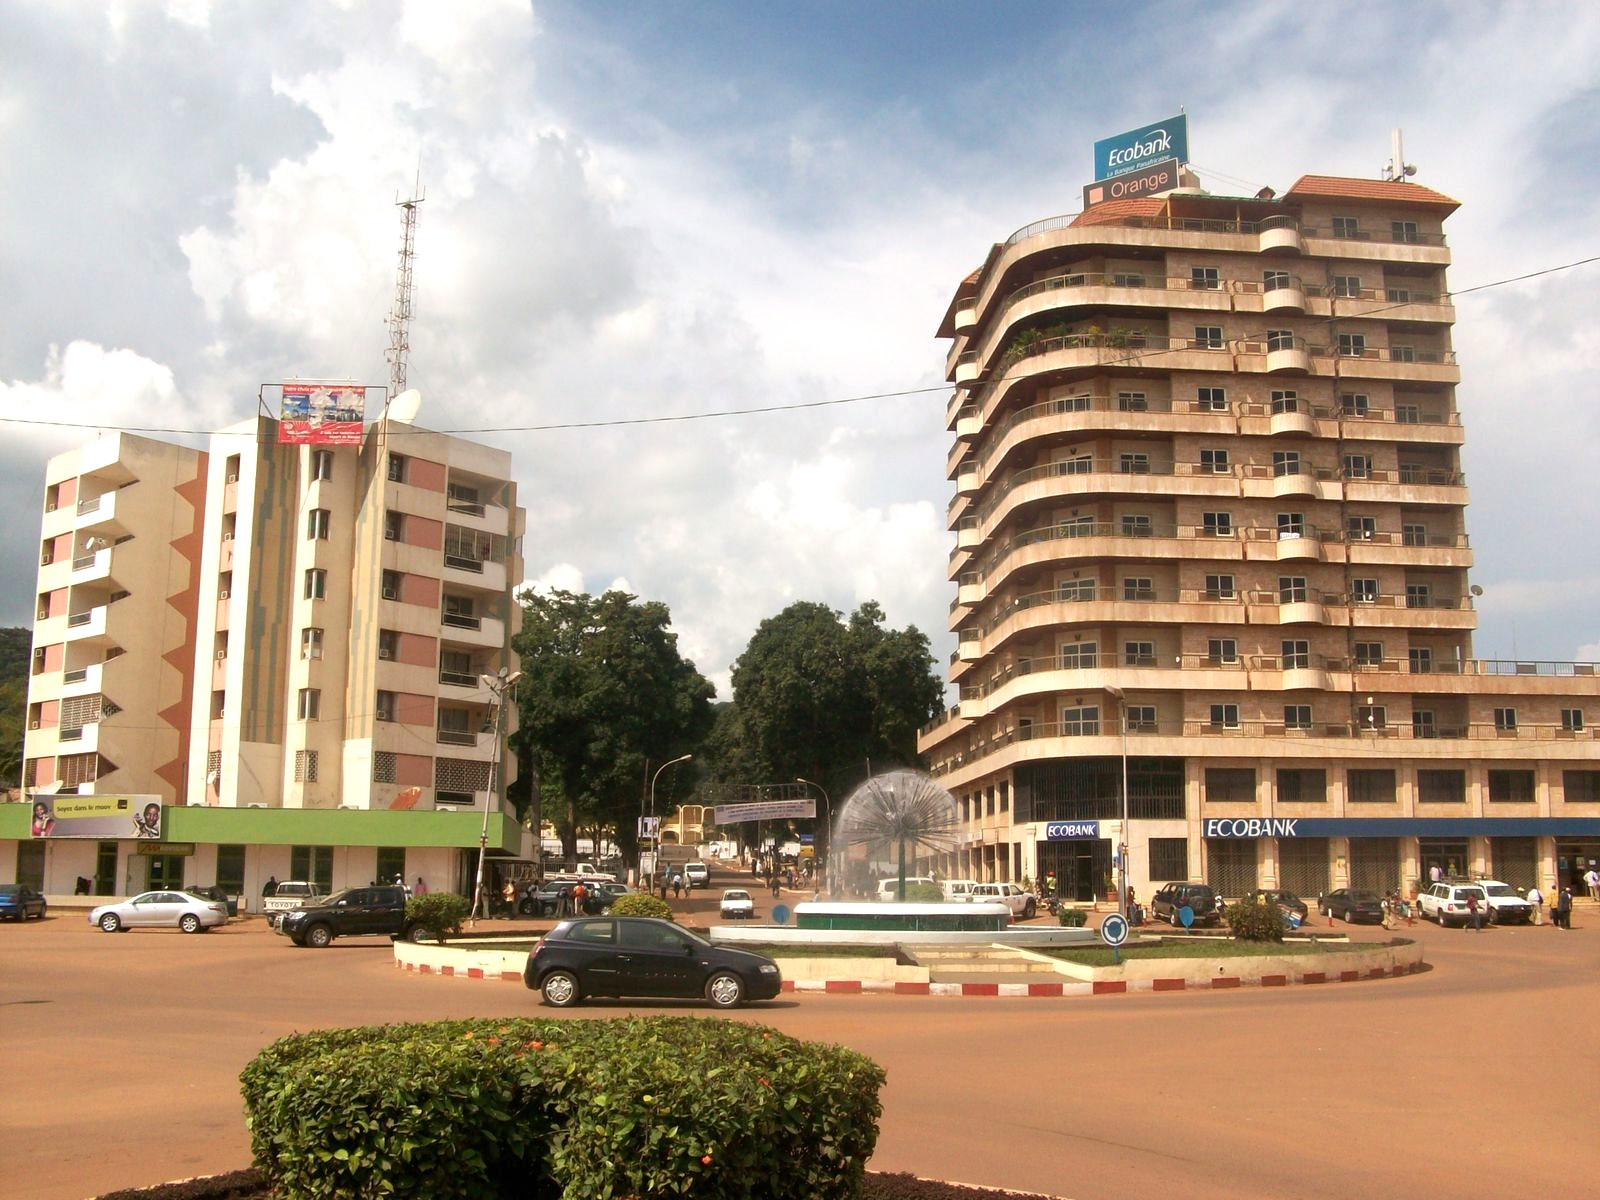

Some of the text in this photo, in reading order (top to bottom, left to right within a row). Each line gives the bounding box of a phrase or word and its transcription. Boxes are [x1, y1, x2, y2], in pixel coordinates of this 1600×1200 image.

[1108, 129, 1172, 167] Ecobank
[1111, 172, 1168, 198] Orange
[1048, 824, 1096, 837] ECOBANK
[1207, 818, 1298, 837] ECOBANK
